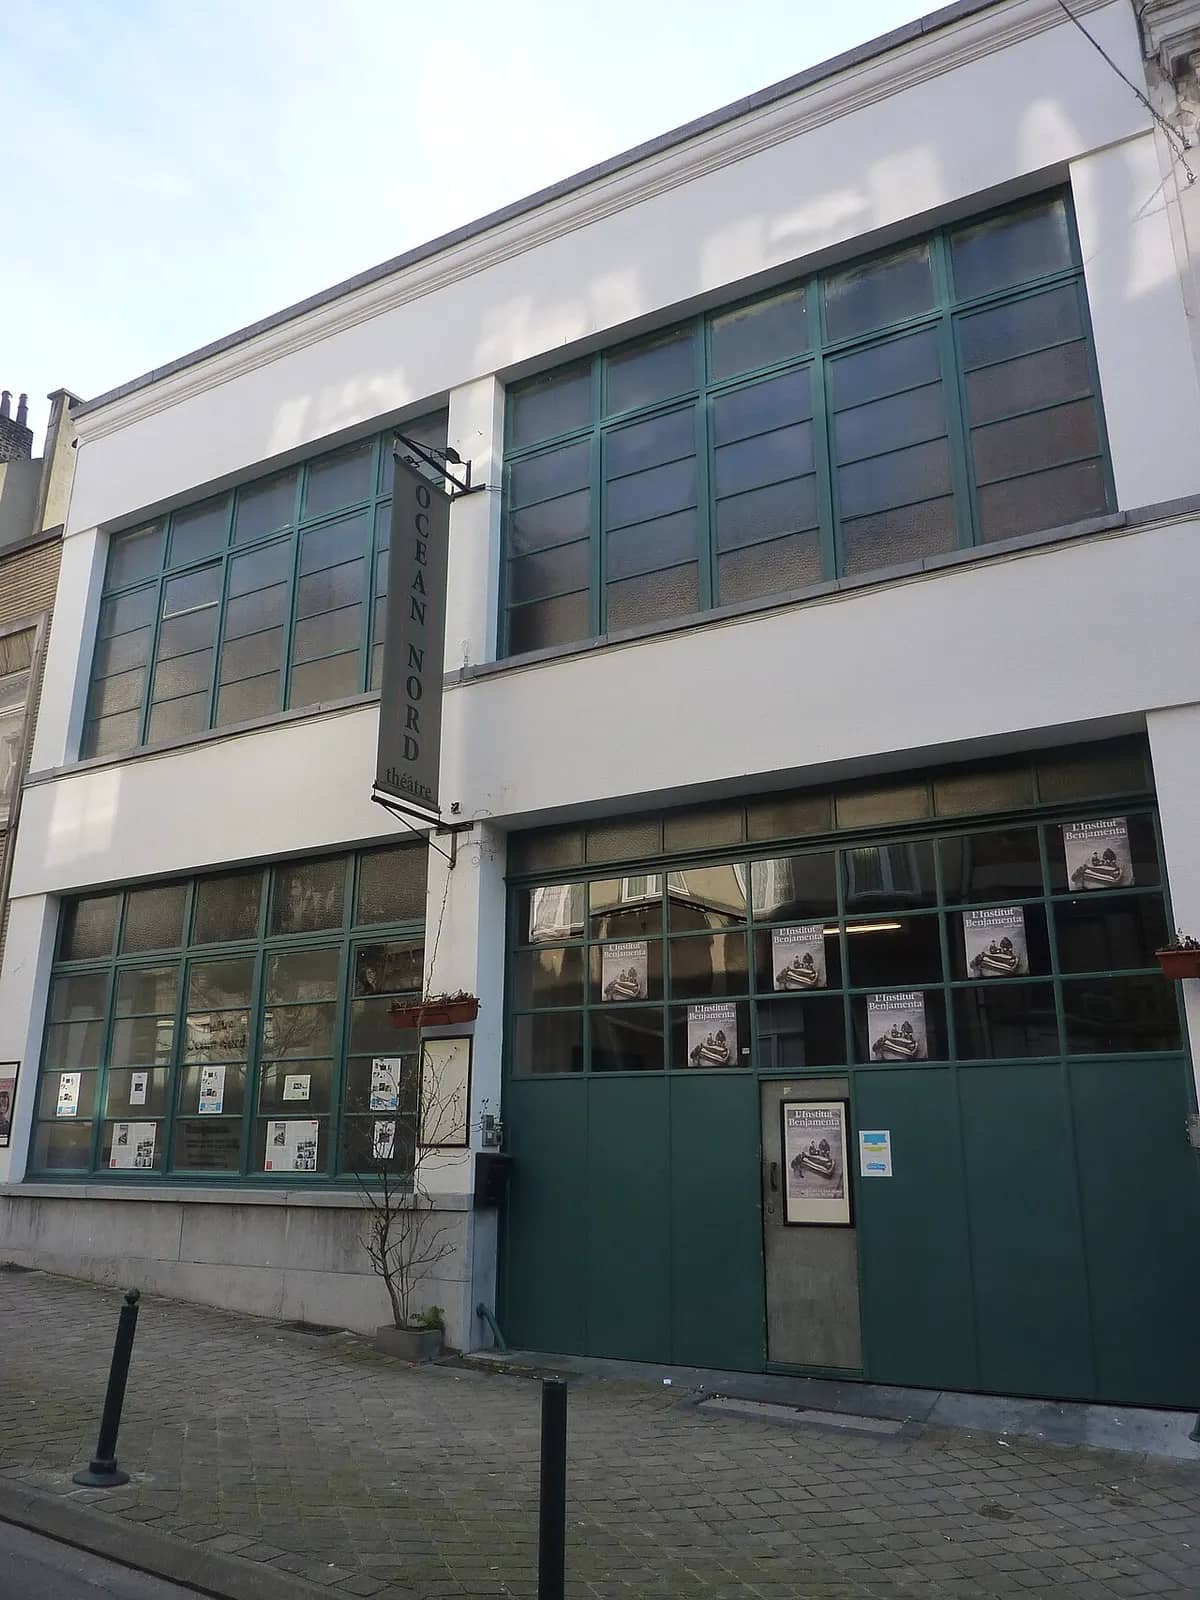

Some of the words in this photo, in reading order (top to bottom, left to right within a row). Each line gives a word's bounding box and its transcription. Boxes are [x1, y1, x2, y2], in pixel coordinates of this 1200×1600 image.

[410, 485, 431, 626] OCEAN
[403, 643, 425, 761] NORD
[1072, 820, 1116, 831] L'Institut
[1065, 827, 1126, 840] Benjamenta
[972, 908, 1014, 919] L'Institut
[965, 916, 1022, 927] Benjamenta
[774, 934, 823, 943] Benjamenta
[875, 992, 914, 1002] L'Institut
[870, 1001, 922, 1010] Benjamenta
[690, 1011, 735, 1020] Benjamenta
[789, 1118, 840, 1127] Benjamenta
